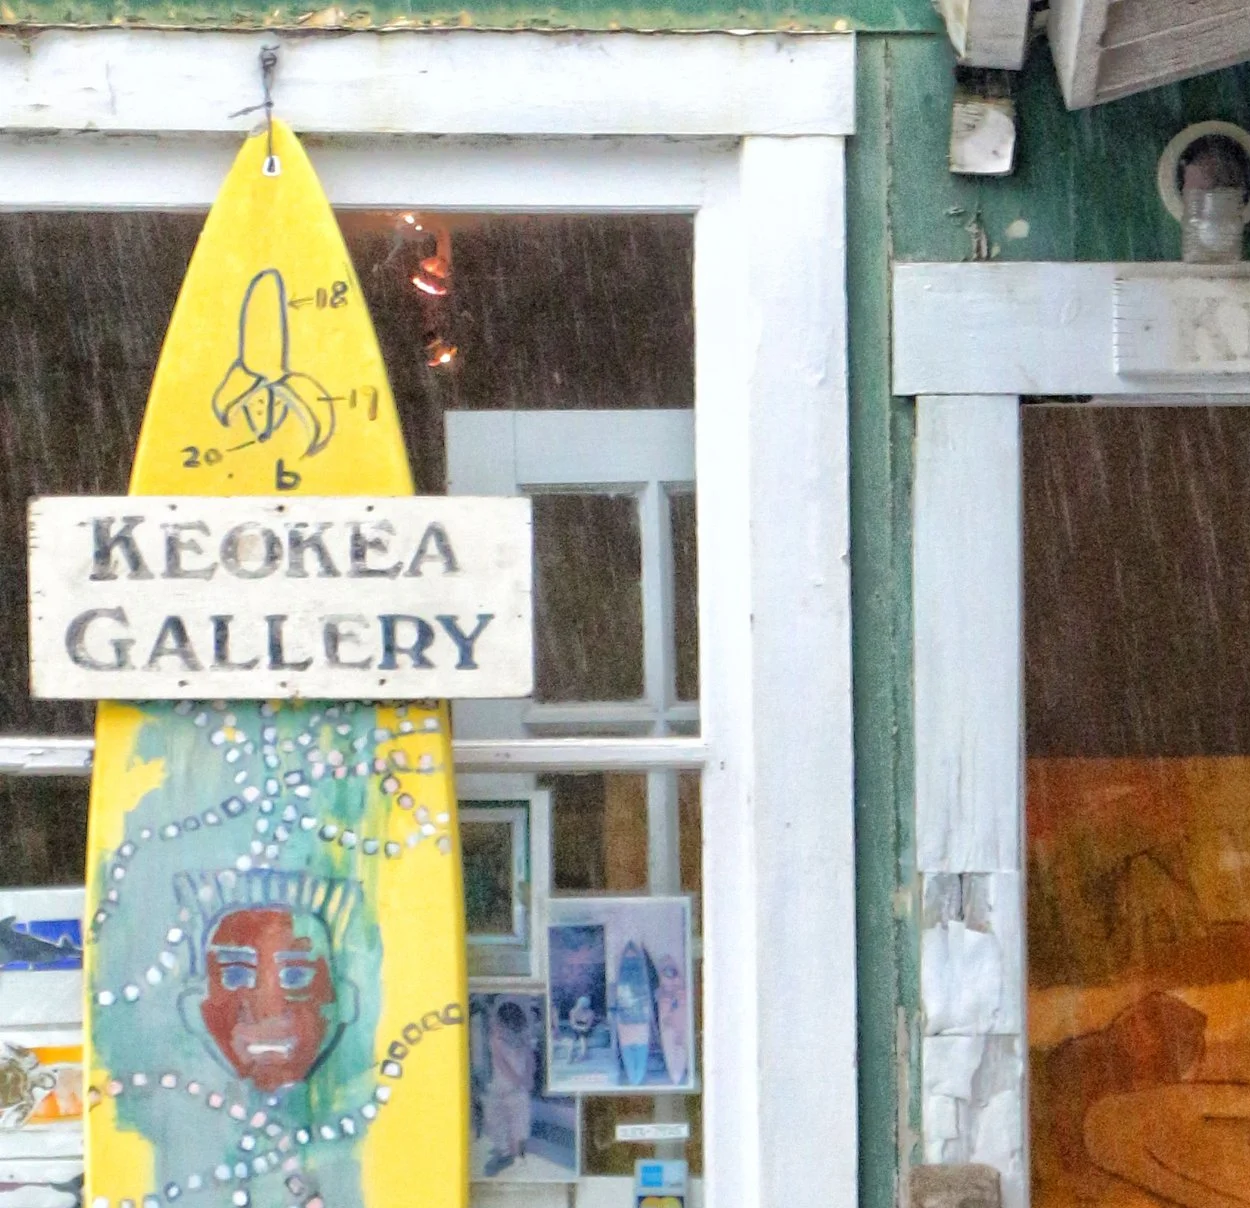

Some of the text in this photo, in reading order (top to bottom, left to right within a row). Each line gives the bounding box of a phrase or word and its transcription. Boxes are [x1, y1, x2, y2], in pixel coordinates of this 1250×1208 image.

[315, 280, 349, 311] 18
[181, 446, 224, 468] 20
[88, 515, 461, 582] KEOKEA
[64, 606, 495, 672] GALLERY
